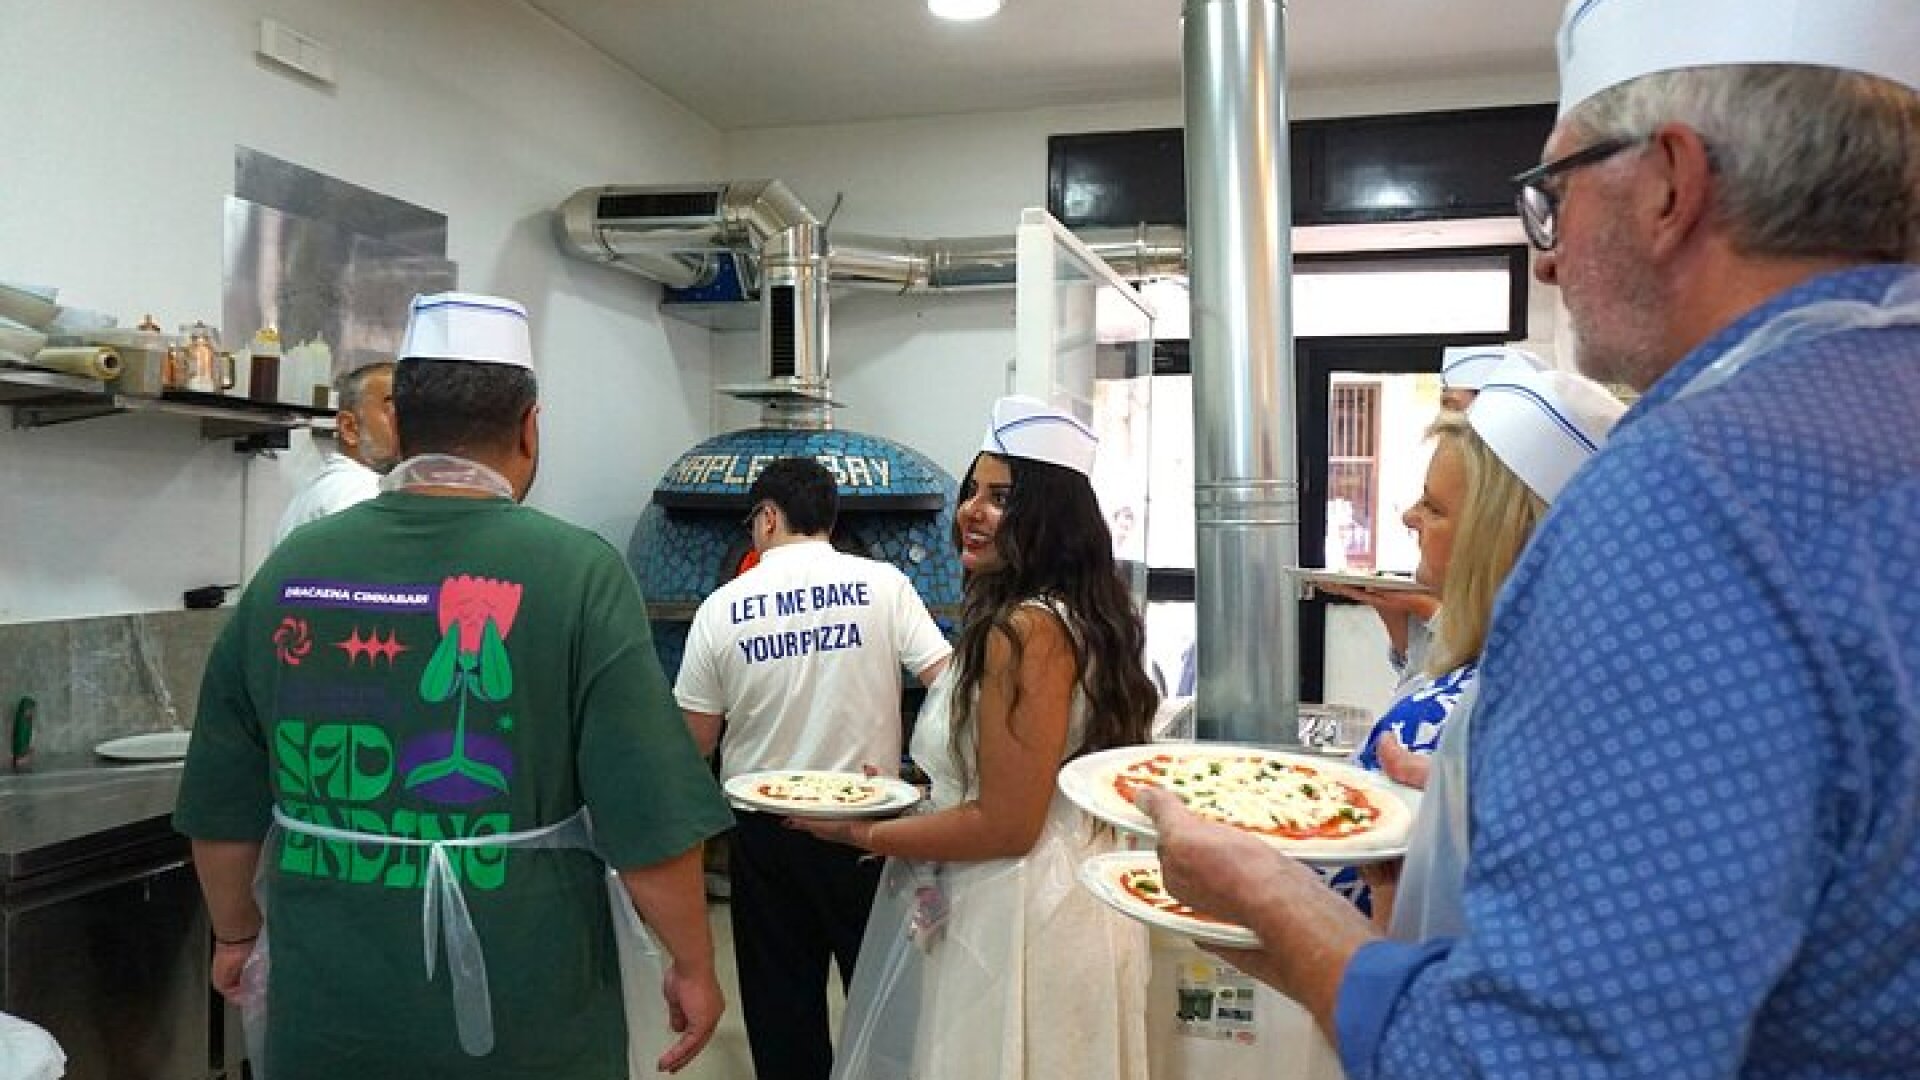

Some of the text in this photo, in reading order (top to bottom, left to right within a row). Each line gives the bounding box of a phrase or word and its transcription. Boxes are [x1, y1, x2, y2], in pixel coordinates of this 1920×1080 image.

[676, 455, 792, 484] NAPLE
[731, 583, 869, 624] LET ME BAKE
[739, 623, 862, 664] YOUR PIZZA
[276, 719, 393, 801] SAD
[280, 803, 510, 889] ENDING
